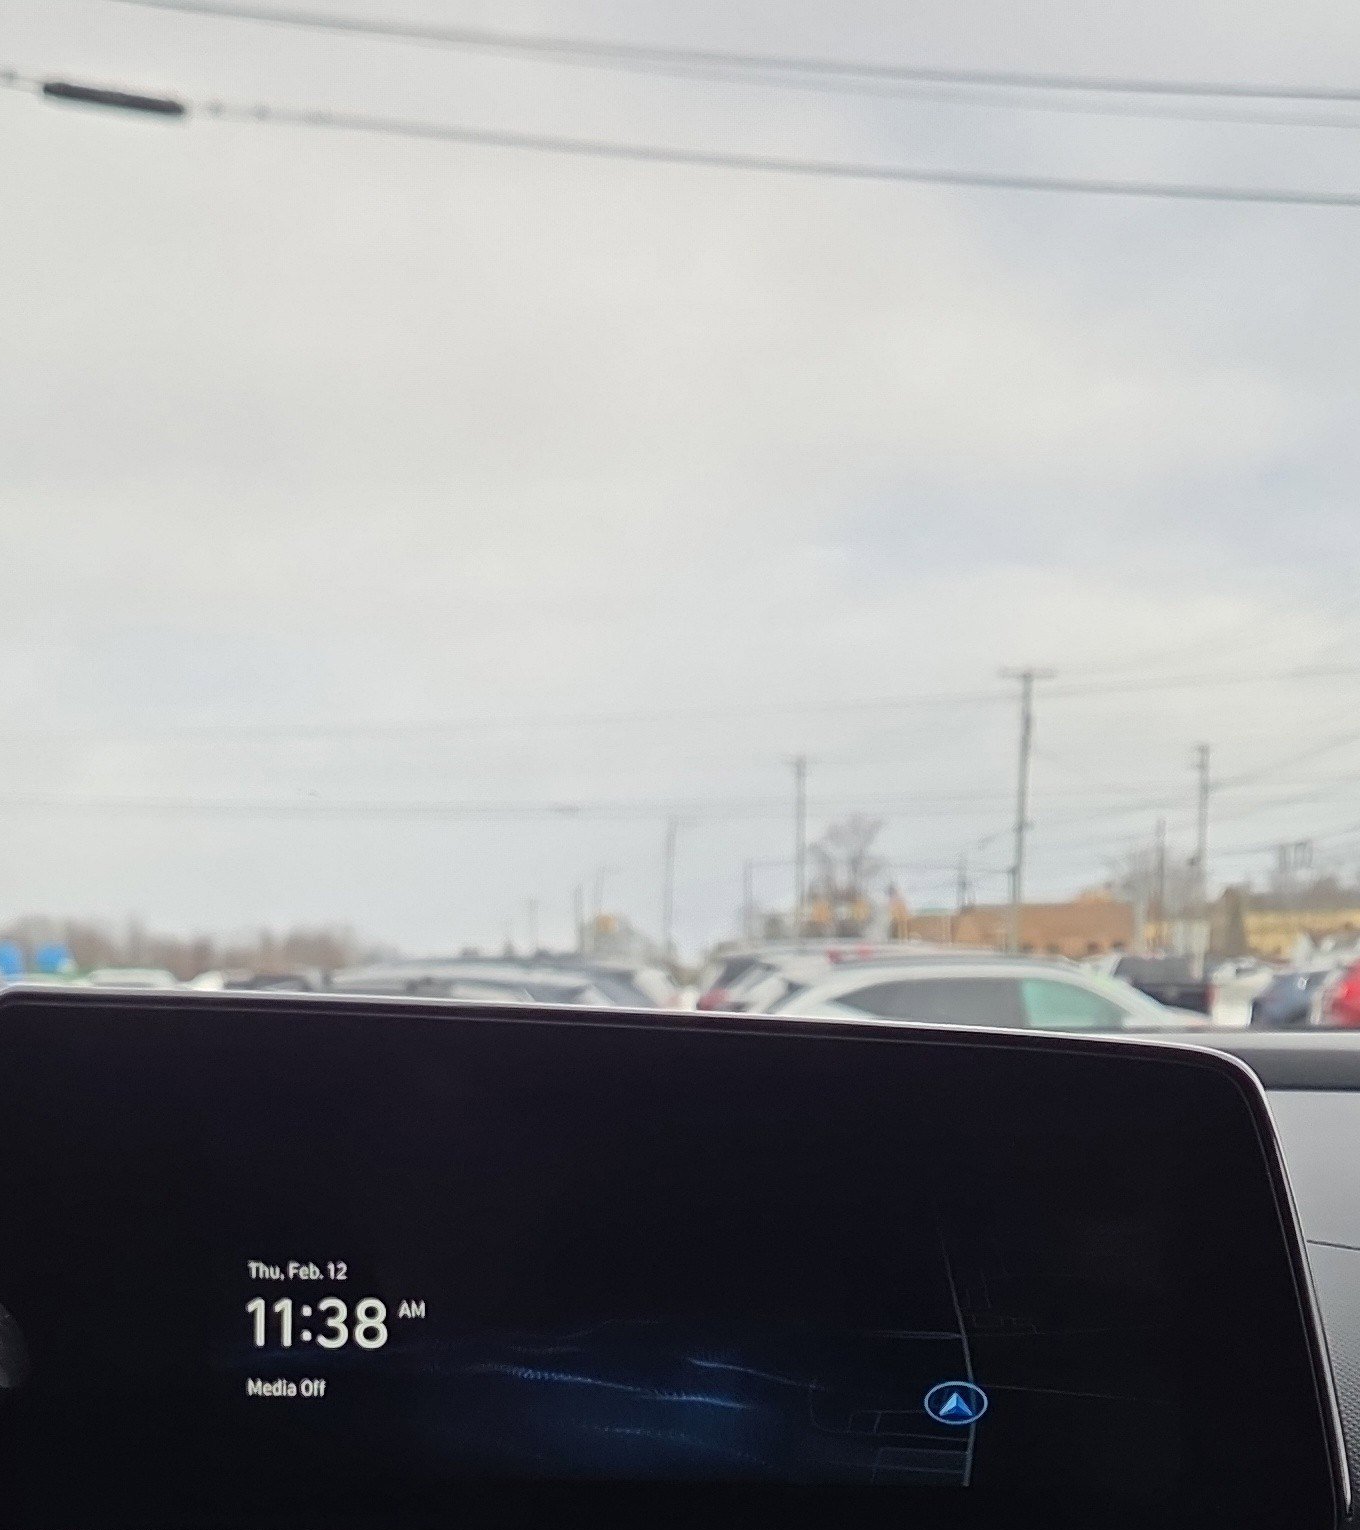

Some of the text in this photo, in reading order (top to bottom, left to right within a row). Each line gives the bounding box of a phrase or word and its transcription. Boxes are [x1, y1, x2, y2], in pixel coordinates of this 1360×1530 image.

[248, 1261, 348, 1280] Thu, Feb. 12
[246, 1297, 426, 1349] 11:38 AM
[246, 1378, 326, 1397] Media Off
